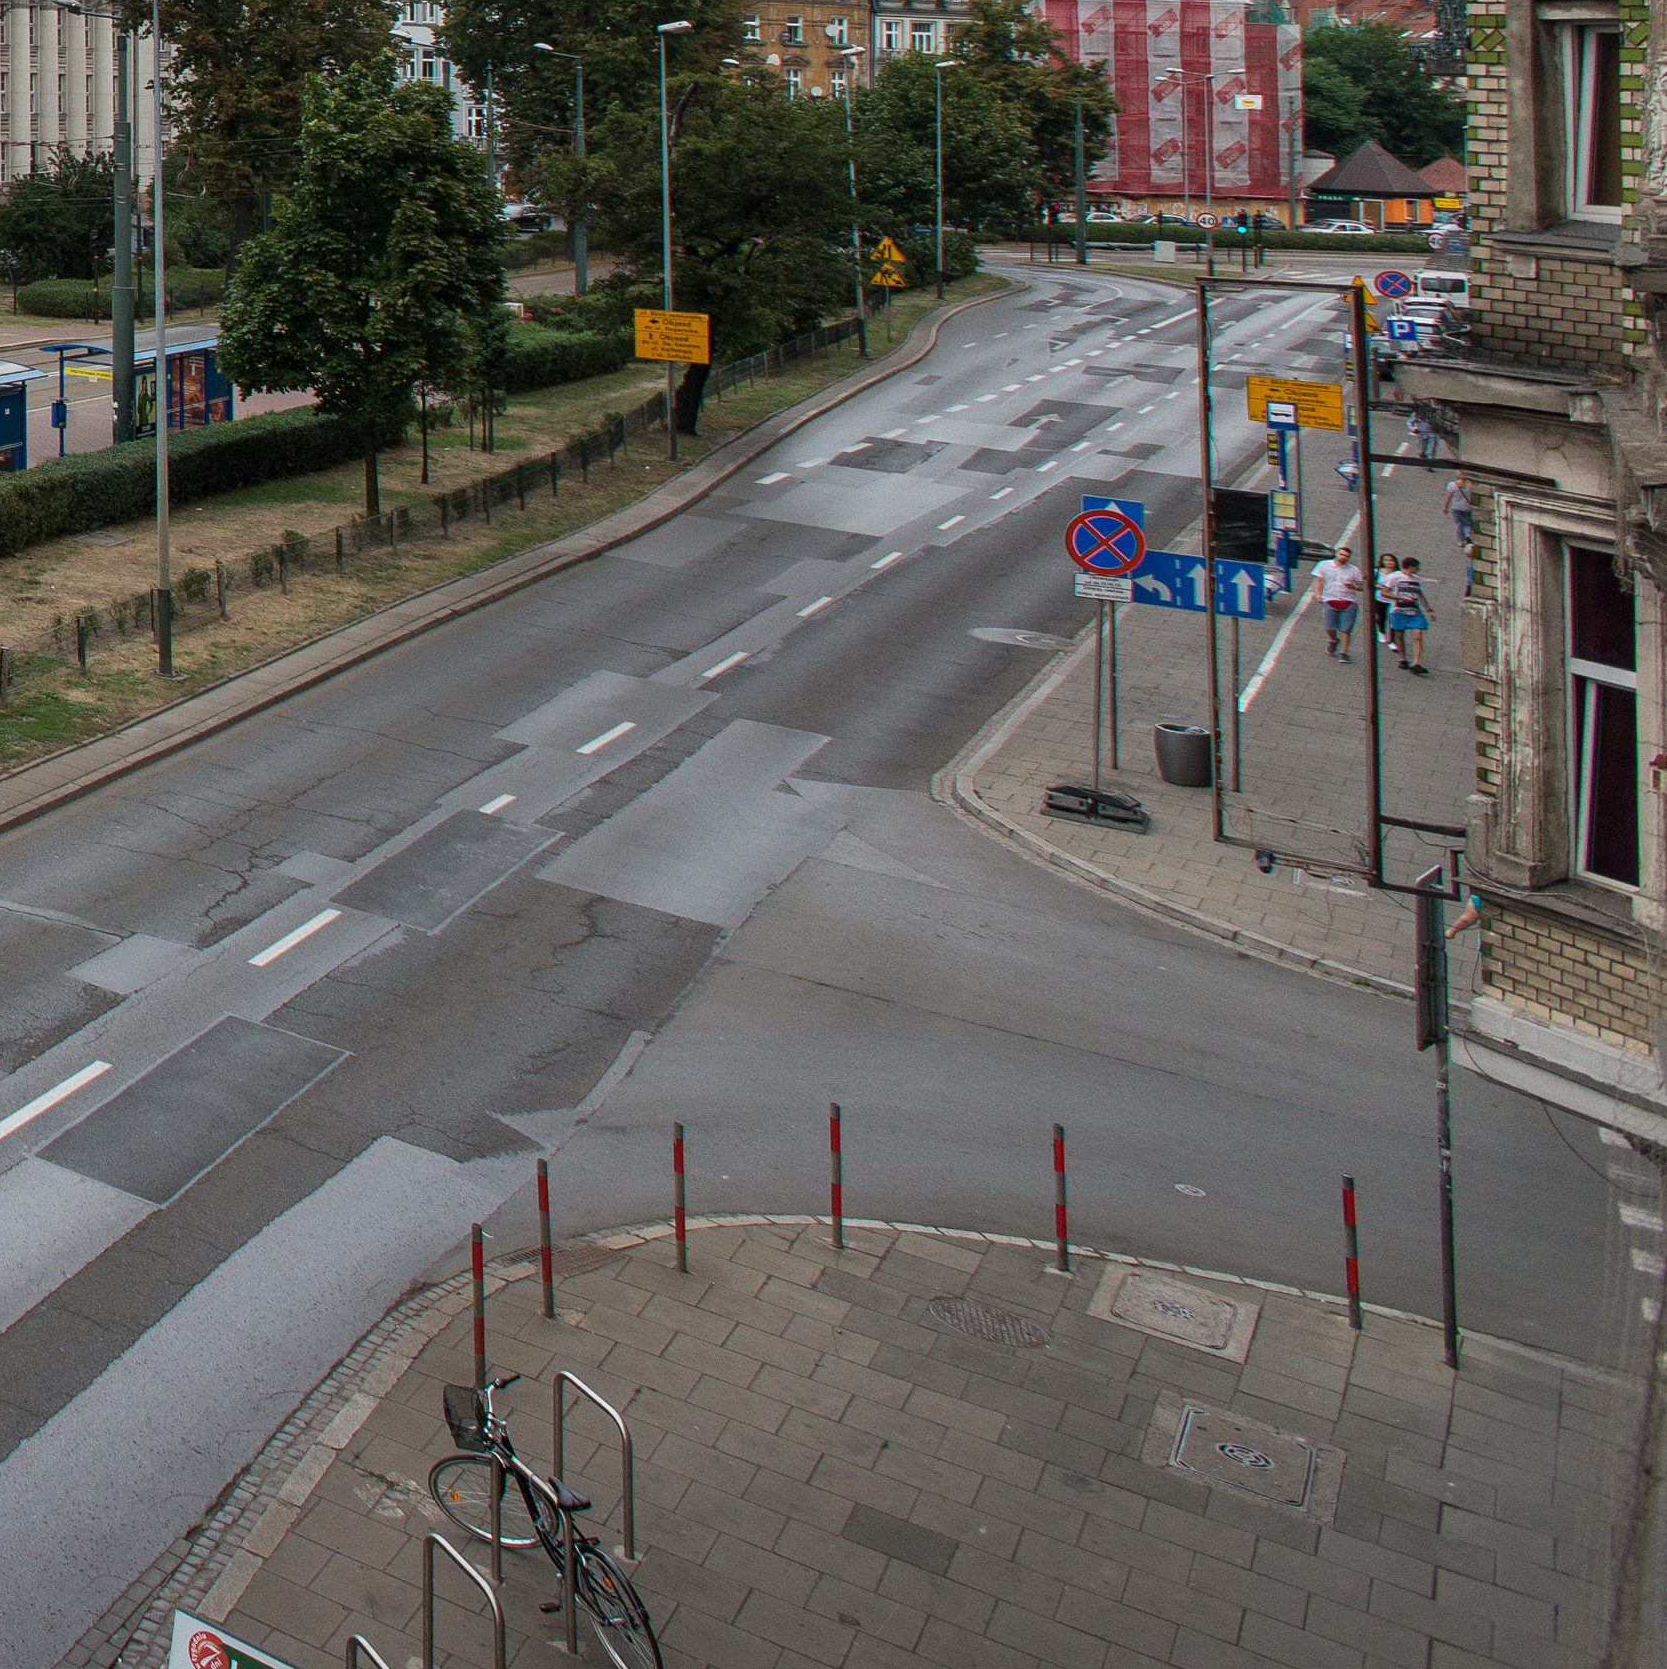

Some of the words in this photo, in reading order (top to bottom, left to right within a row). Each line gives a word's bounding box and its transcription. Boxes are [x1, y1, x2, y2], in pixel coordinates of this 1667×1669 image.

[1199, 216, 1215, 226] 40
[662, 318, 691, 327] Objazd
[1395, 321, 1409, 333] P
[659, 333, 689, 342] Objazd
[1284, 388, 1318, 398] Objazd
[200, 1643, 222, 1667] 7
[210, 1657, 223, 1669] dni
